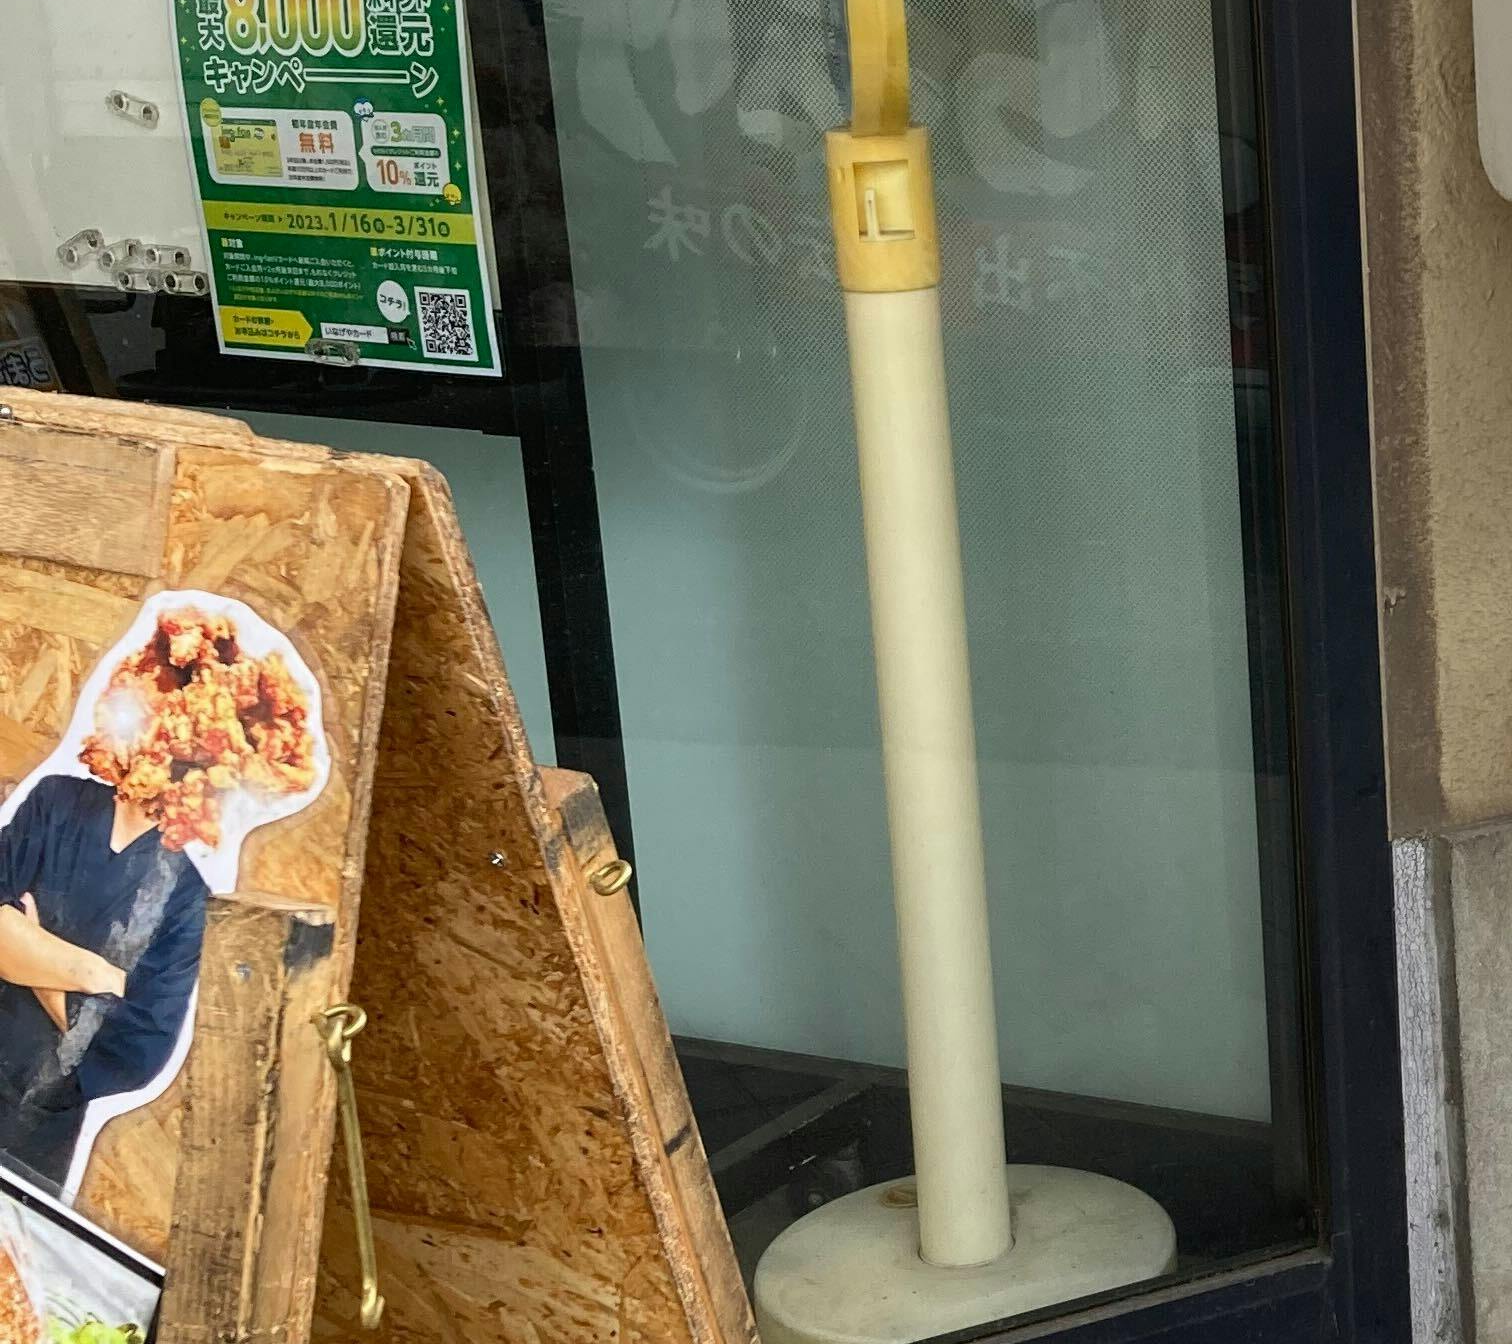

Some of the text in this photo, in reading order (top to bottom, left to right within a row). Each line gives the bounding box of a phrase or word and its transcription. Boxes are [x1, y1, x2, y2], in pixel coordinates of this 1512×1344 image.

[367, 11, 434, 58] 還元
[203, 55, 440, 99] キャンペーン
[298, 131, 335, 154] 無料
[376, 159, 440, 188] 10% ポイント 還元
[324, 326, 374, 338] いなげやカード
